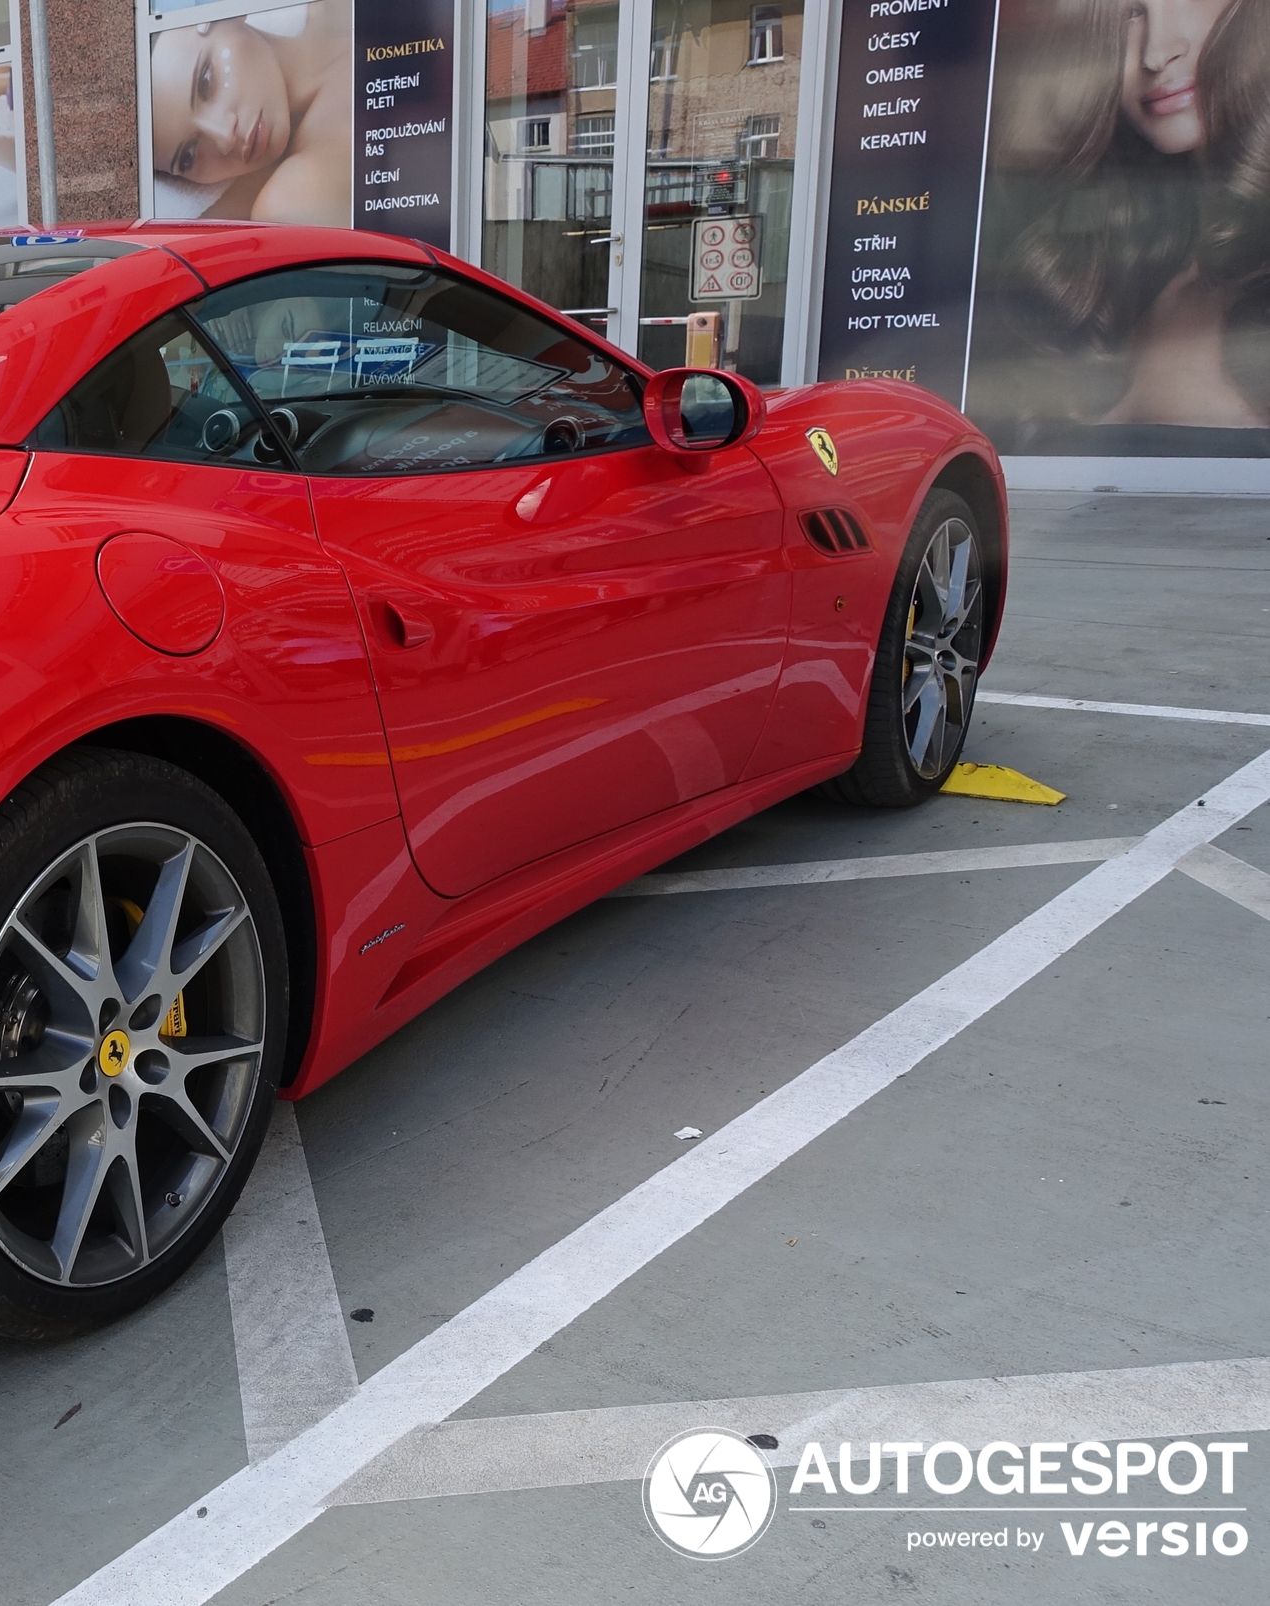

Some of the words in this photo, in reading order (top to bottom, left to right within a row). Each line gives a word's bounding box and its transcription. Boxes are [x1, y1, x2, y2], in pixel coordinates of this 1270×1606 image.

[366, 38, 445, 62] KOSMETIKA
[868, 31, 921, 52] ÚČESY
[366, 72, 420, 94] OŠETŘENÍ
[866, 64, 925, 85] OMBRE
[366, 95, 395, 110] PLETI
[863, 97, 921, 118] MELÍRY
[365, 118, 446, 142] PRODLUŽOVÁNÍ
[861, 130, 927, 150] KERATIN
[365, 144, 385, 157] ŘAS
[365, 168, 401, 185] LÍČENÍ
[365, 193, 440, 212] DIAGNOSTIKA
[856, 191, 930, 216] PÁNSKÉ
[854, 234, 897, 252] STŘIH
[851, 266, 912, 283] ÚPRAVA
[851, 282, 905, 301] VOUSŮ
[363, 317, 422, 333] RELAXAČNÍ
[848, 316, 881, 330] HOT
[885, 313, 941, 329] TOWEL
